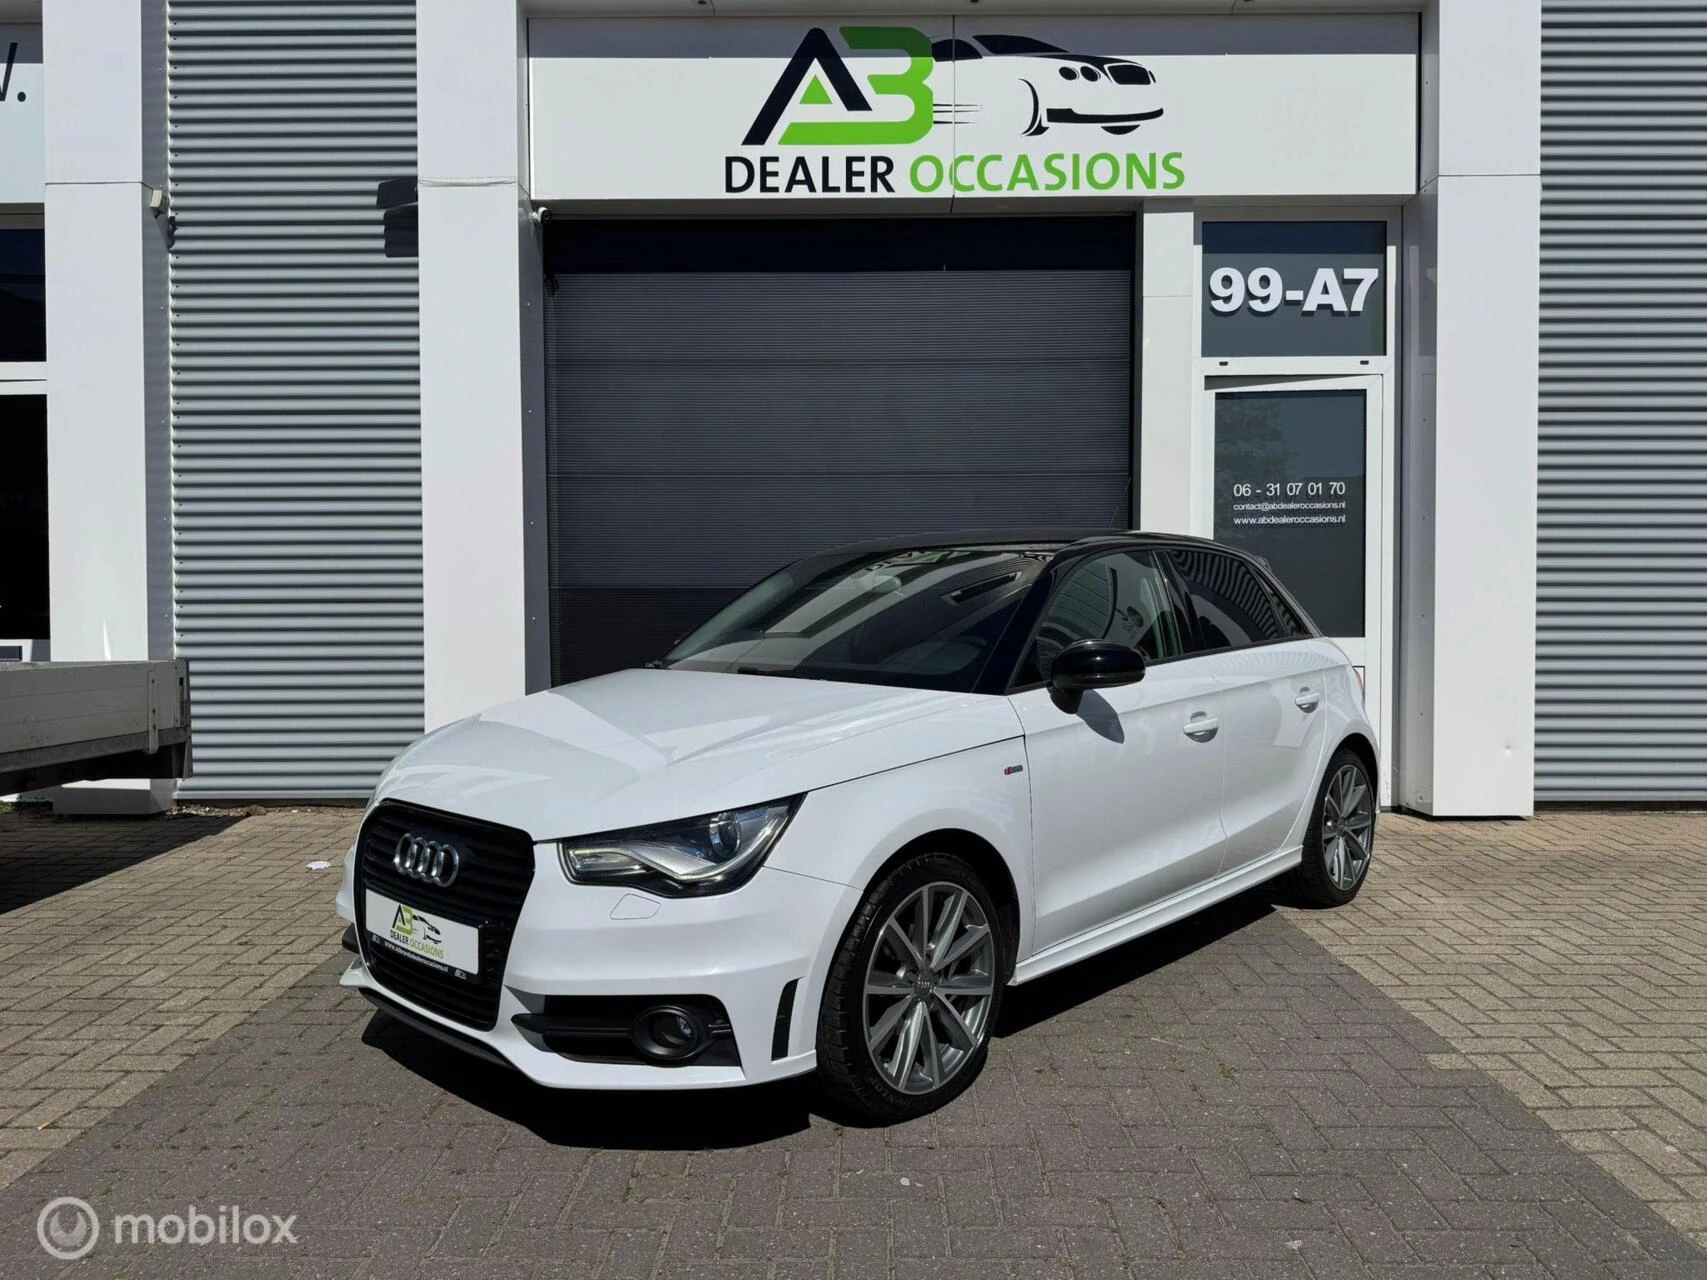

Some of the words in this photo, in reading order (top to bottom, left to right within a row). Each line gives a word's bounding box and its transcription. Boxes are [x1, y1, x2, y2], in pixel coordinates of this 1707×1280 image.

[725, 155, 895, 193] DEALER
[909, 151, 1186, 193] OCCASIONS
[1209, 266, 1379, 314] 99-A7
[1233, 483, 1251, 497] 06
[1266, 482, 1280, 496] 31
[1286, 482, 1303, 496] 07
[1307, 482, 1322, 495] 01
[1329, 481, 1346, 495] 70
[1233, 501, 1346, 512] contact@abdealeroccasions.nl
[1233, 514, 1346, 525] www.abdealeroccasions.nl
[390, 929, 410, 945] DEALER
[409, 936, 444, 960] OCCASIONS
